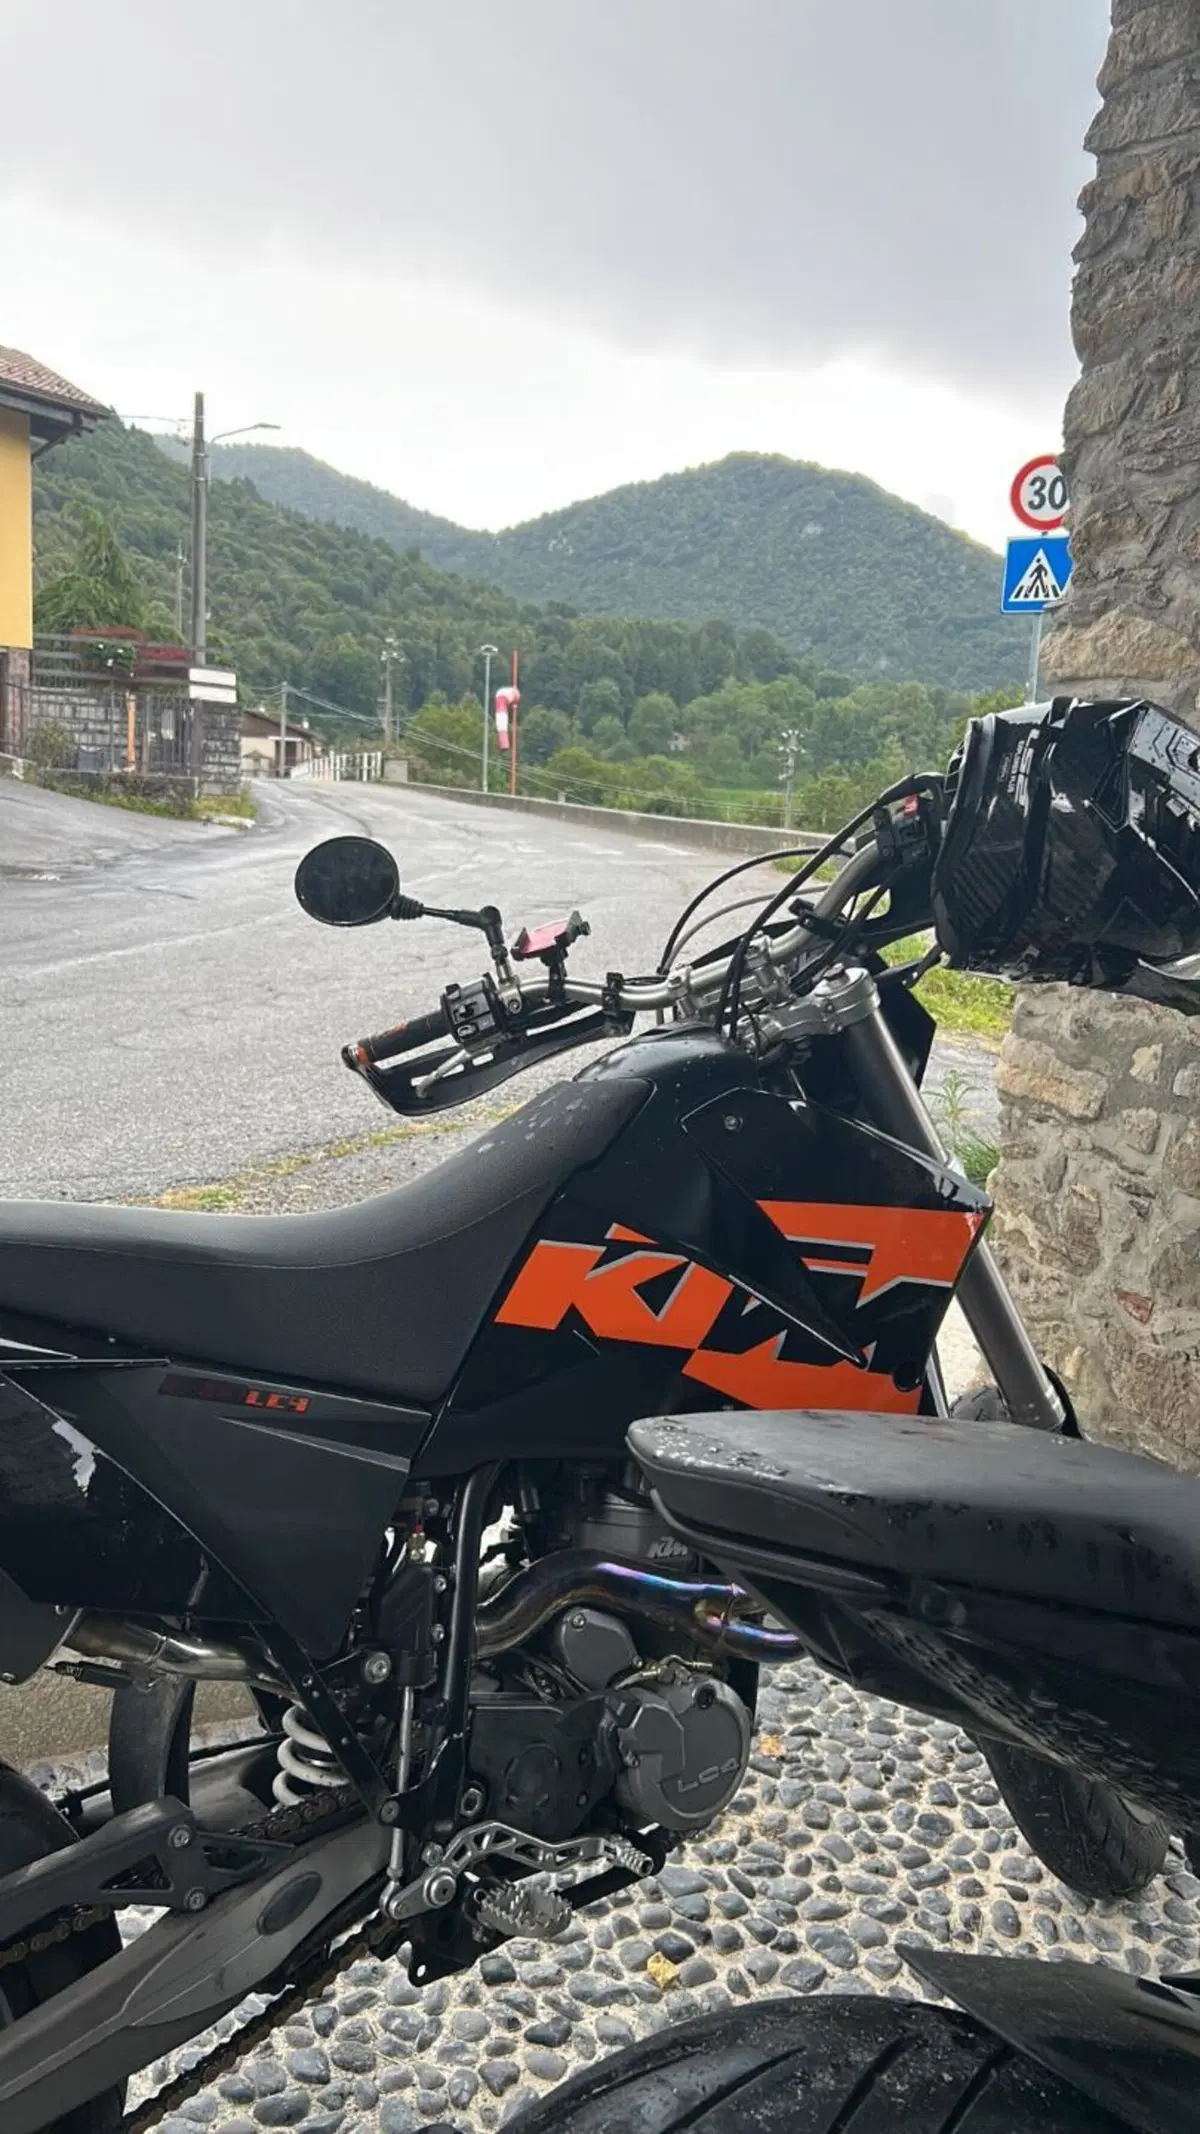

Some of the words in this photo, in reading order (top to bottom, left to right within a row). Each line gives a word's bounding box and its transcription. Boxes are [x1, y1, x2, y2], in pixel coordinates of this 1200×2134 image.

[1027, 475, 1067, 510] 30
[244, 1388, 311, 1413] LC4
[647, 1536, 688, 1559] KTM
